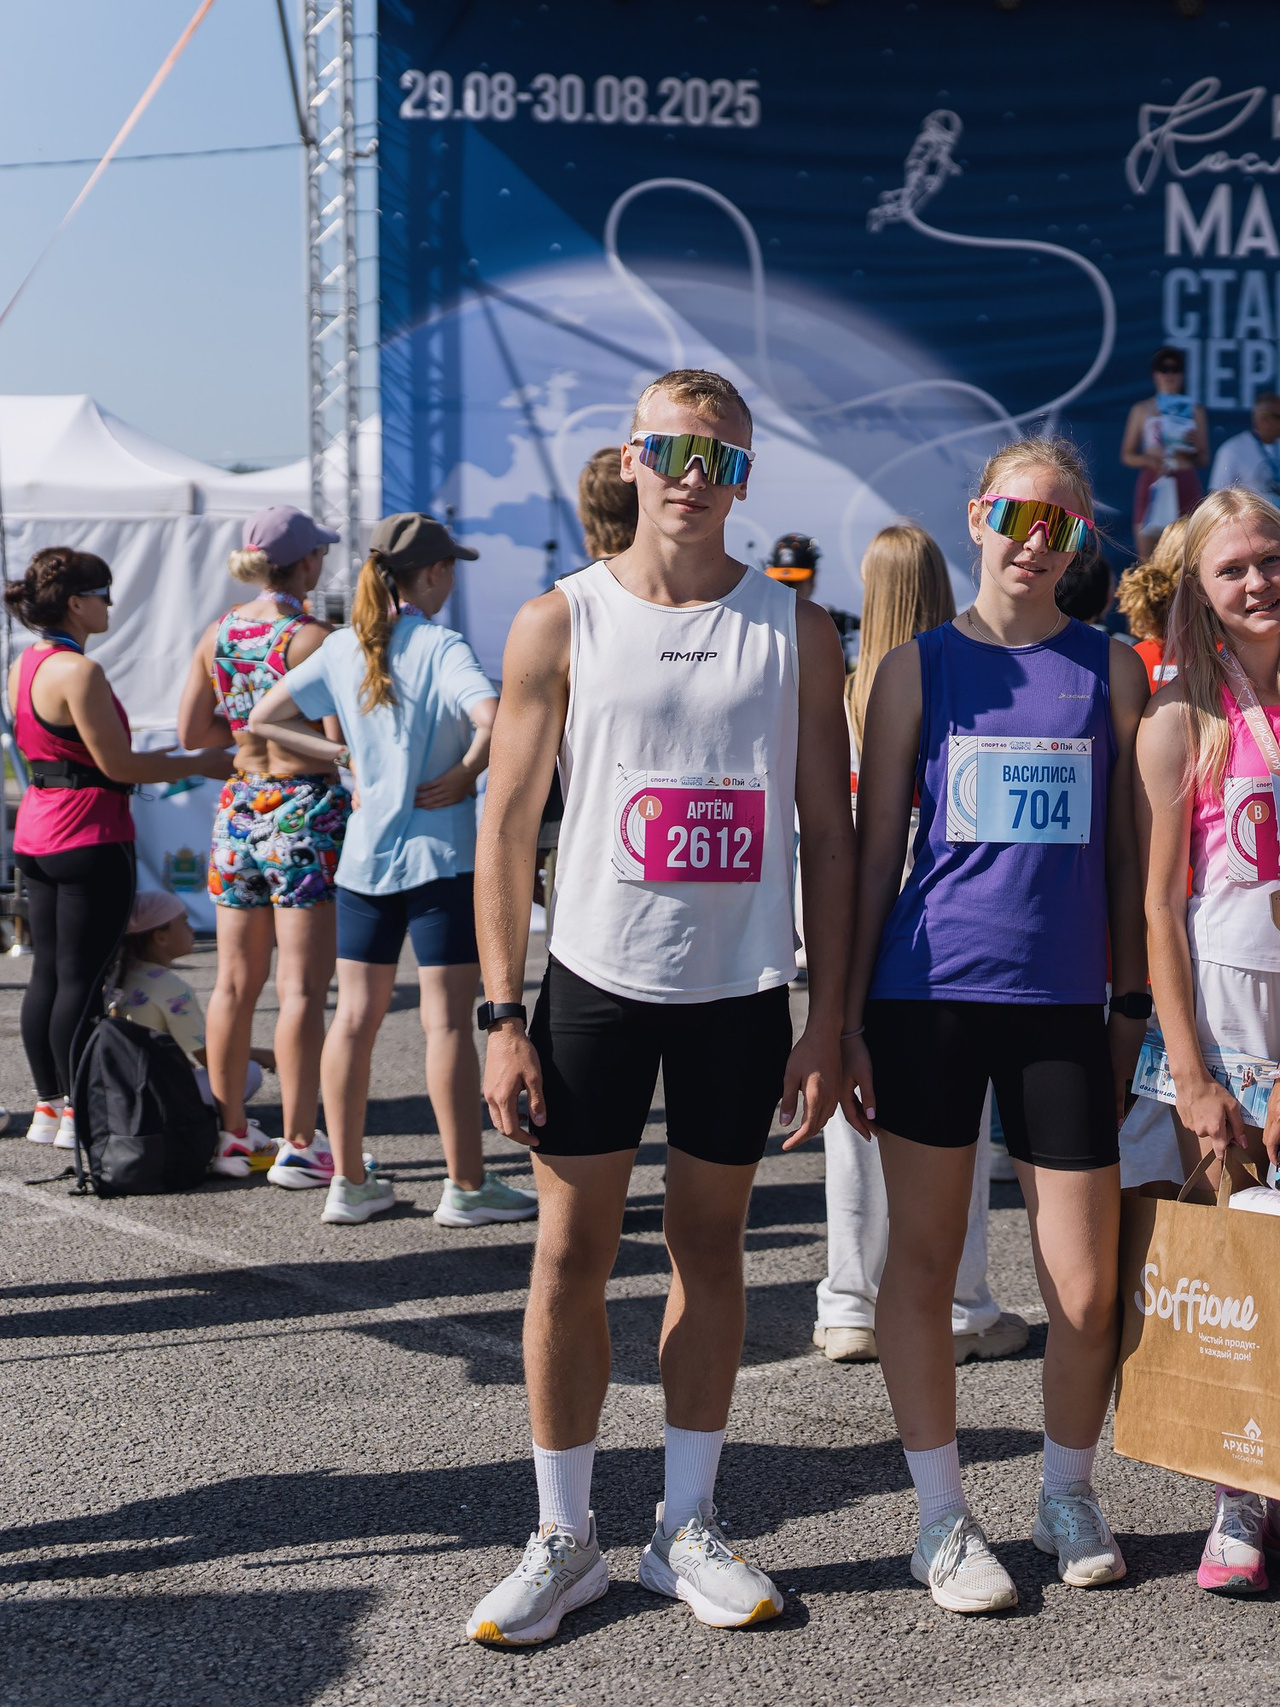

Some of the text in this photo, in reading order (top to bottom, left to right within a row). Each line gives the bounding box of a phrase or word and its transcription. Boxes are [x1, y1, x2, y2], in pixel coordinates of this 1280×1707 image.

[399, 69, 761, 128] 29.08-30.08.2025
[659, 651, 718, 662] AMRP
[732, 778, 745, 786] Пэй
[1002, 765, 1077, 784] ВАСИЛИСА
[645, 800, 655, 816] А
[686, 799, 733, 820] АРТЁМ
[1008, 789, 1071, 830] 704
[666, 825, 751, 869] 2612
[1134, 1263, 1259, 1334] Soffione
[1198, 1332, 1223, 1345] Чистый
[1199, 1346, 1252, 1362] в каждый дом!
[1223, 1439, 1264, 1458] АРХБУМ
